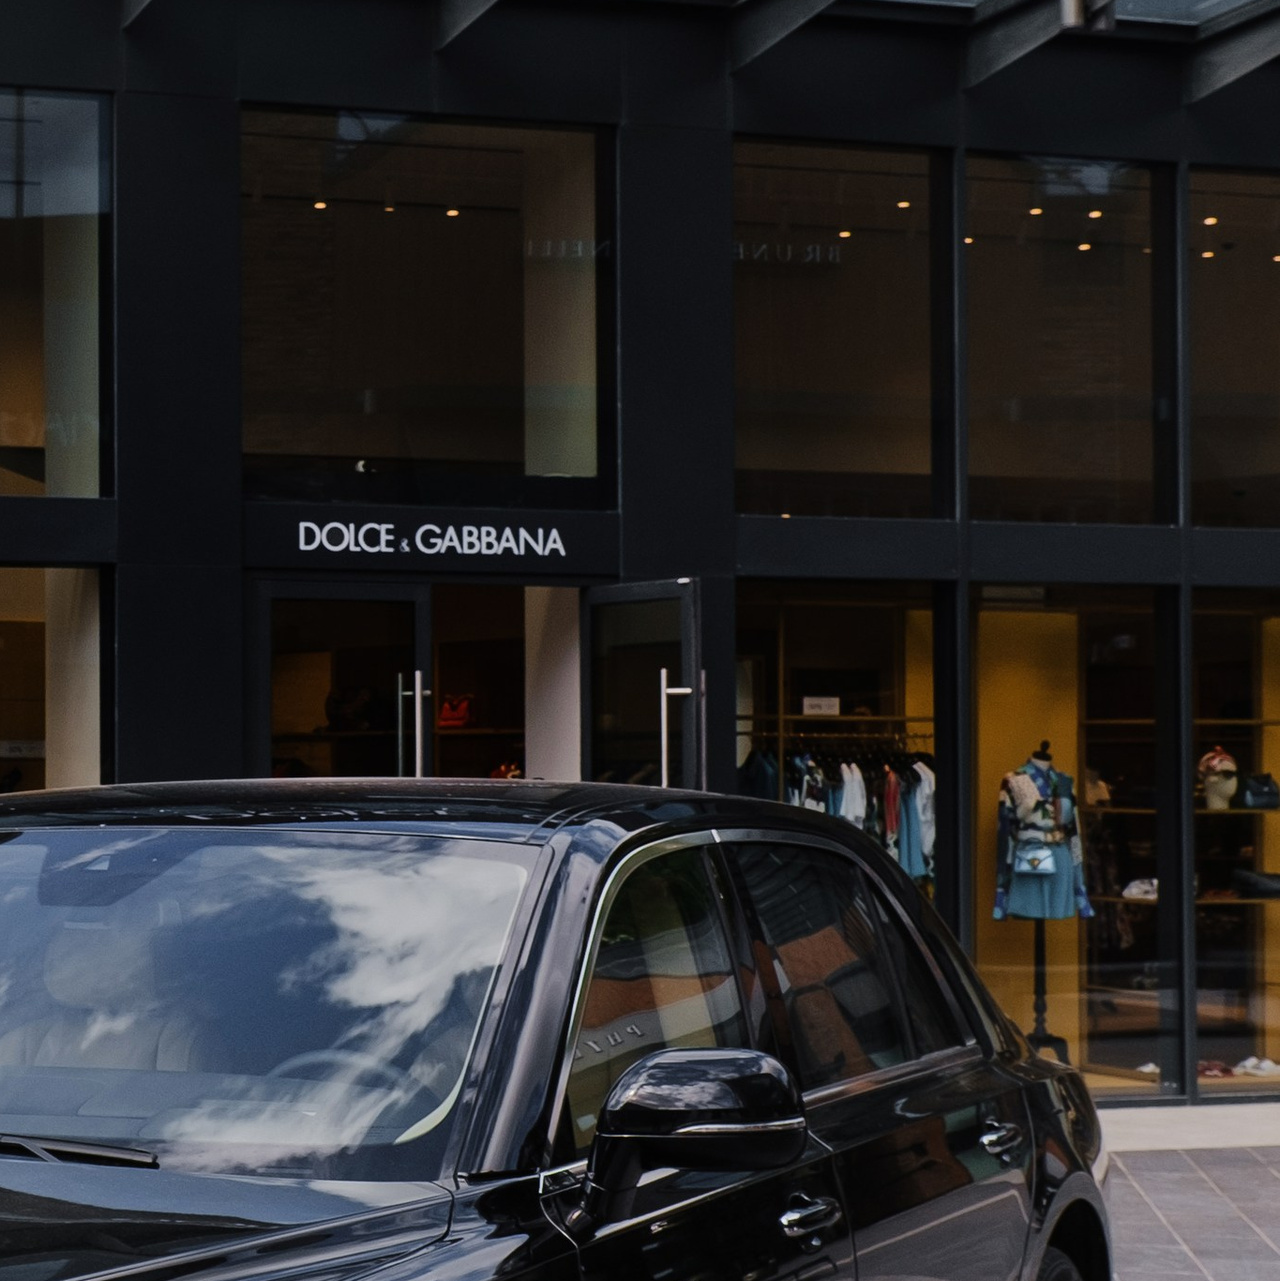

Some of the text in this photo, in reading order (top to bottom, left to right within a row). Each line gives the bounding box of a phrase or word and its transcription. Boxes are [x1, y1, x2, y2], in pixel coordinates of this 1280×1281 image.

[298, 521, 567, 557] DOLCE & GABBANA
